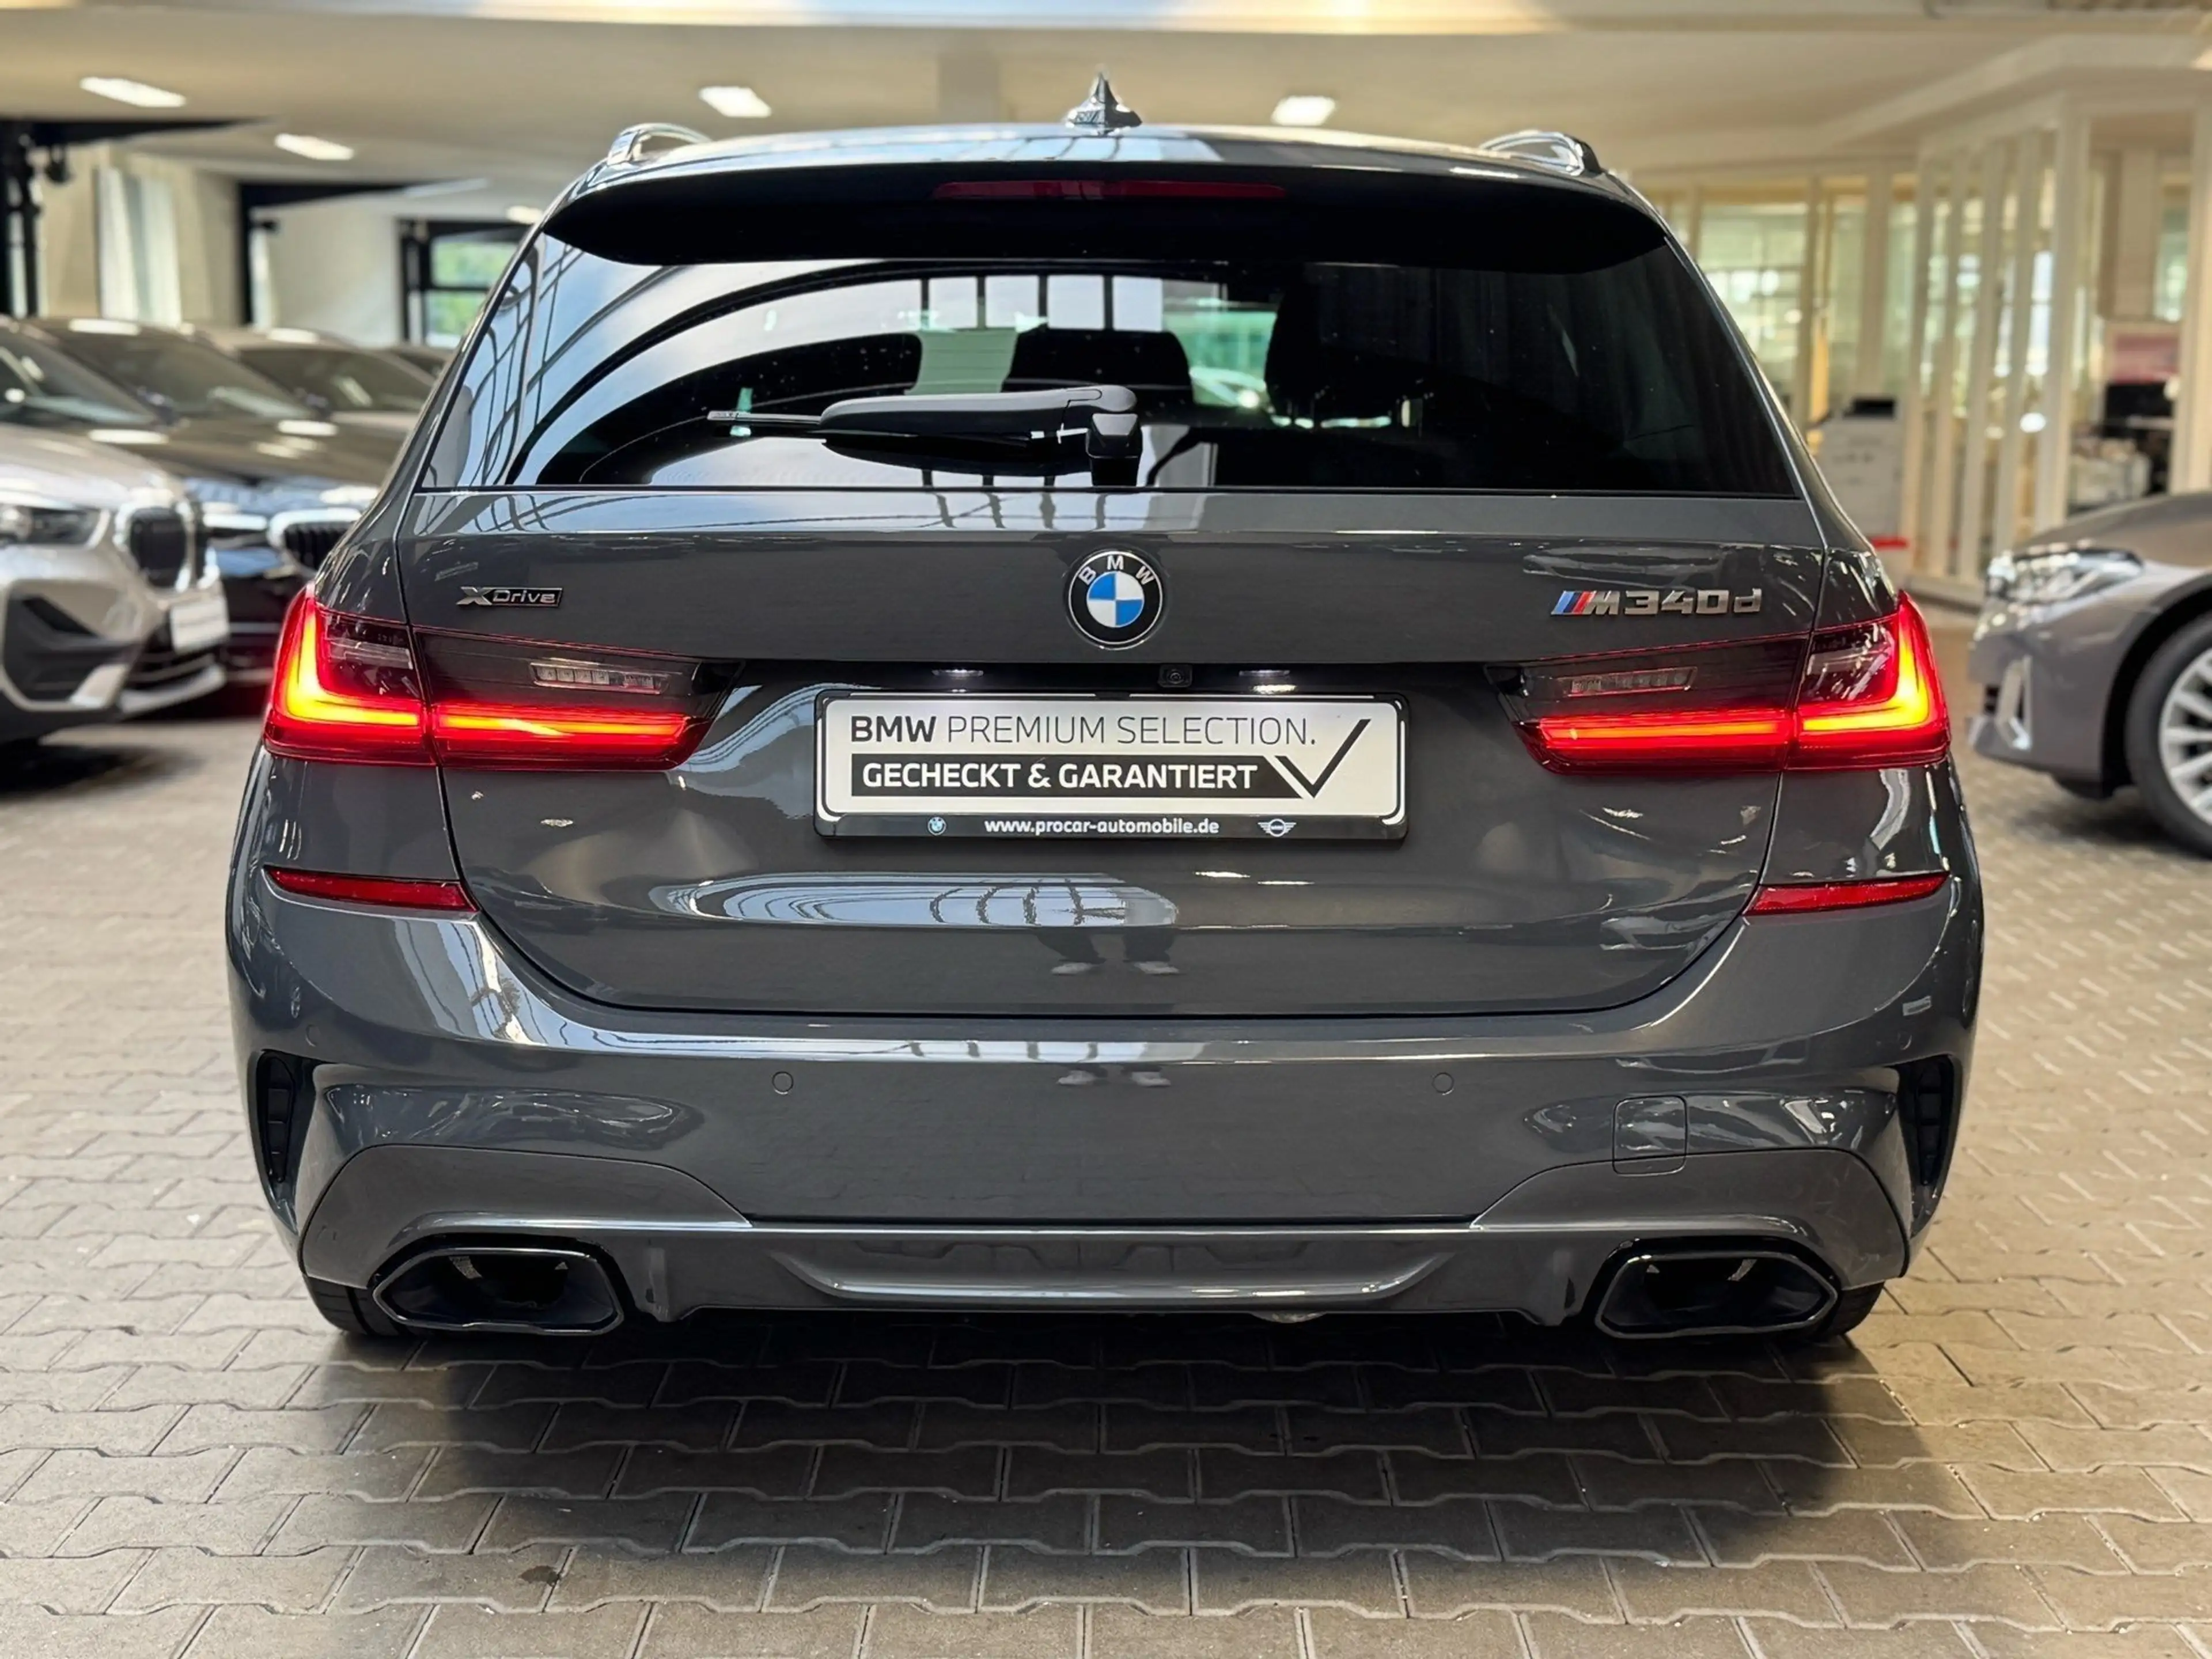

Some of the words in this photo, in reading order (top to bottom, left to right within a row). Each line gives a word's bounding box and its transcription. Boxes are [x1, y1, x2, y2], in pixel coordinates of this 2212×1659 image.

[1078, 555, 1154, 585] BMW
[1577, 588, 1763, 616] M340d
[851, 715, 937, 743] BMW
[948, 716, 1105, 743] PREMIUM
[1117, 717, 1316, 745] SELECTION.
[863, 763, 1021, 788] GECHECKT
[1028, 763, 1052, 789] &
[1059, 763, 1258, 789] GARANTIERT
[984, 817, 1220, 836] www.procar-automobile.de
